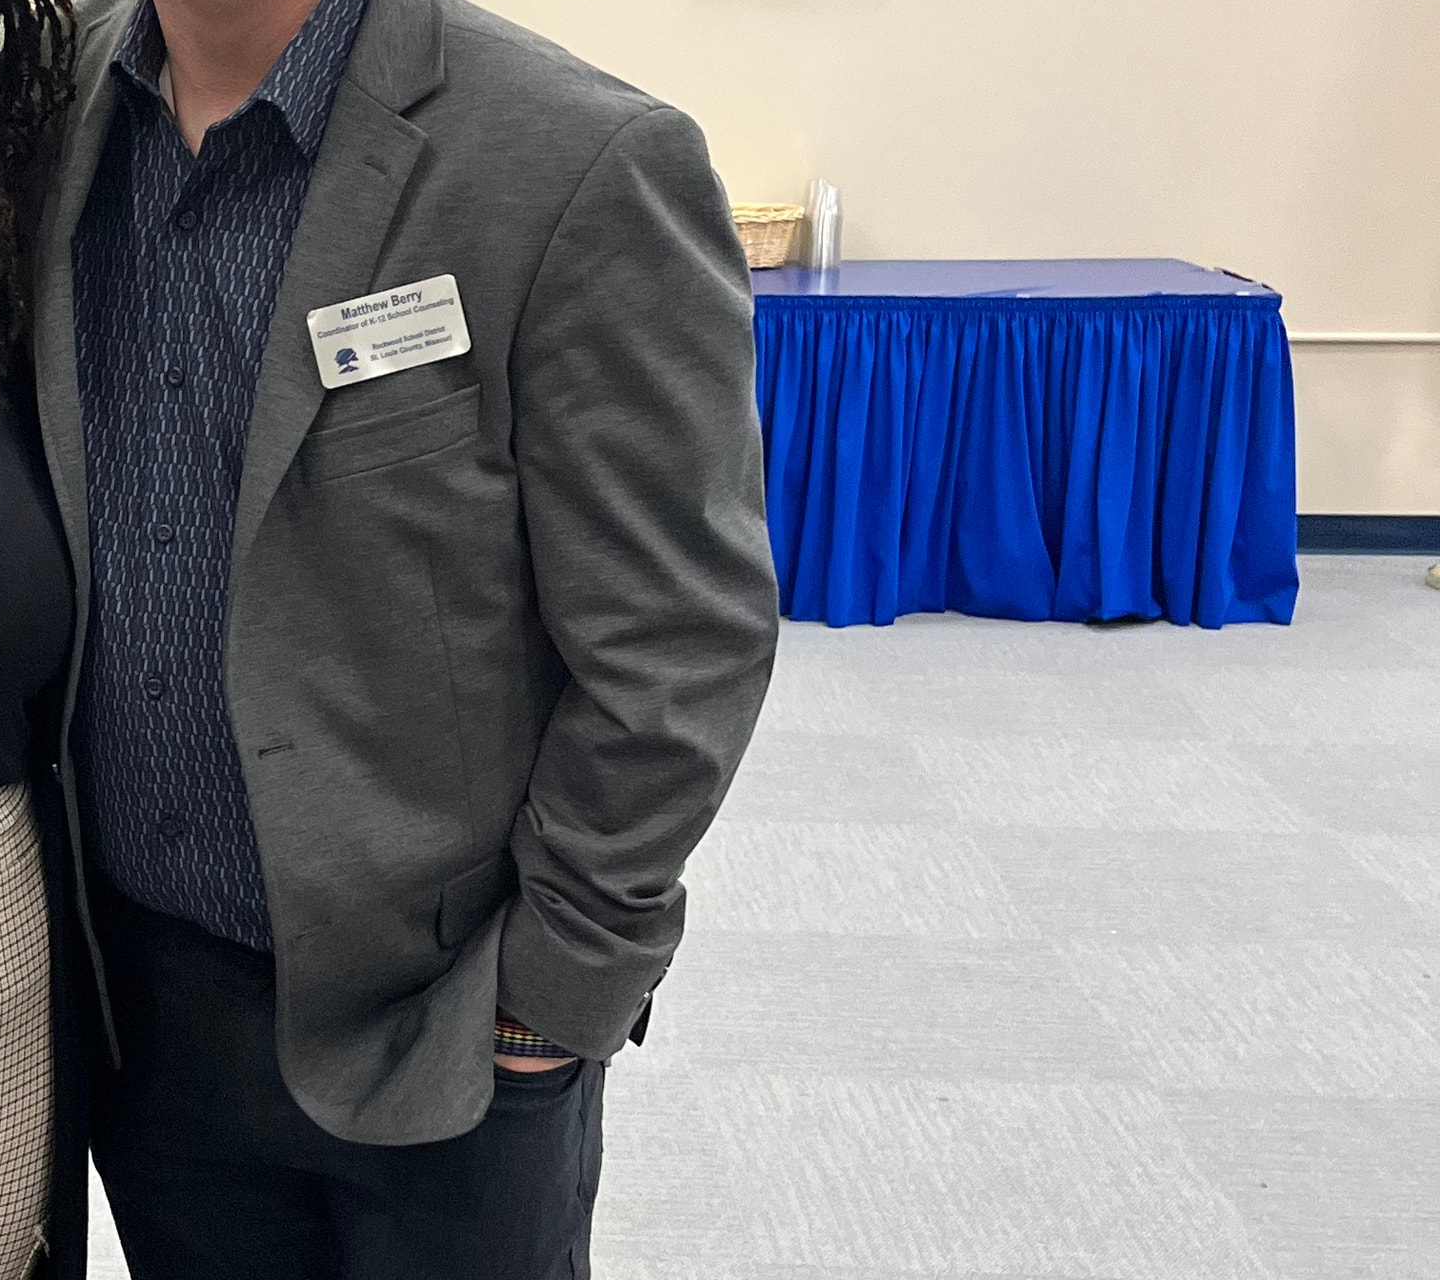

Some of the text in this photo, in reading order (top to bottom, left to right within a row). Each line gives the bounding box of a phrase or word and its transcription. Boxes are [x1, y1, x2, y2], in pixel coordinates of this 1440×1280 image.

[317, 297, 454, 339] Coordinator of K-12 School Counseling
[341, 290, 423, 320] Matthew Berry
[404, 332, 423, 343] School
